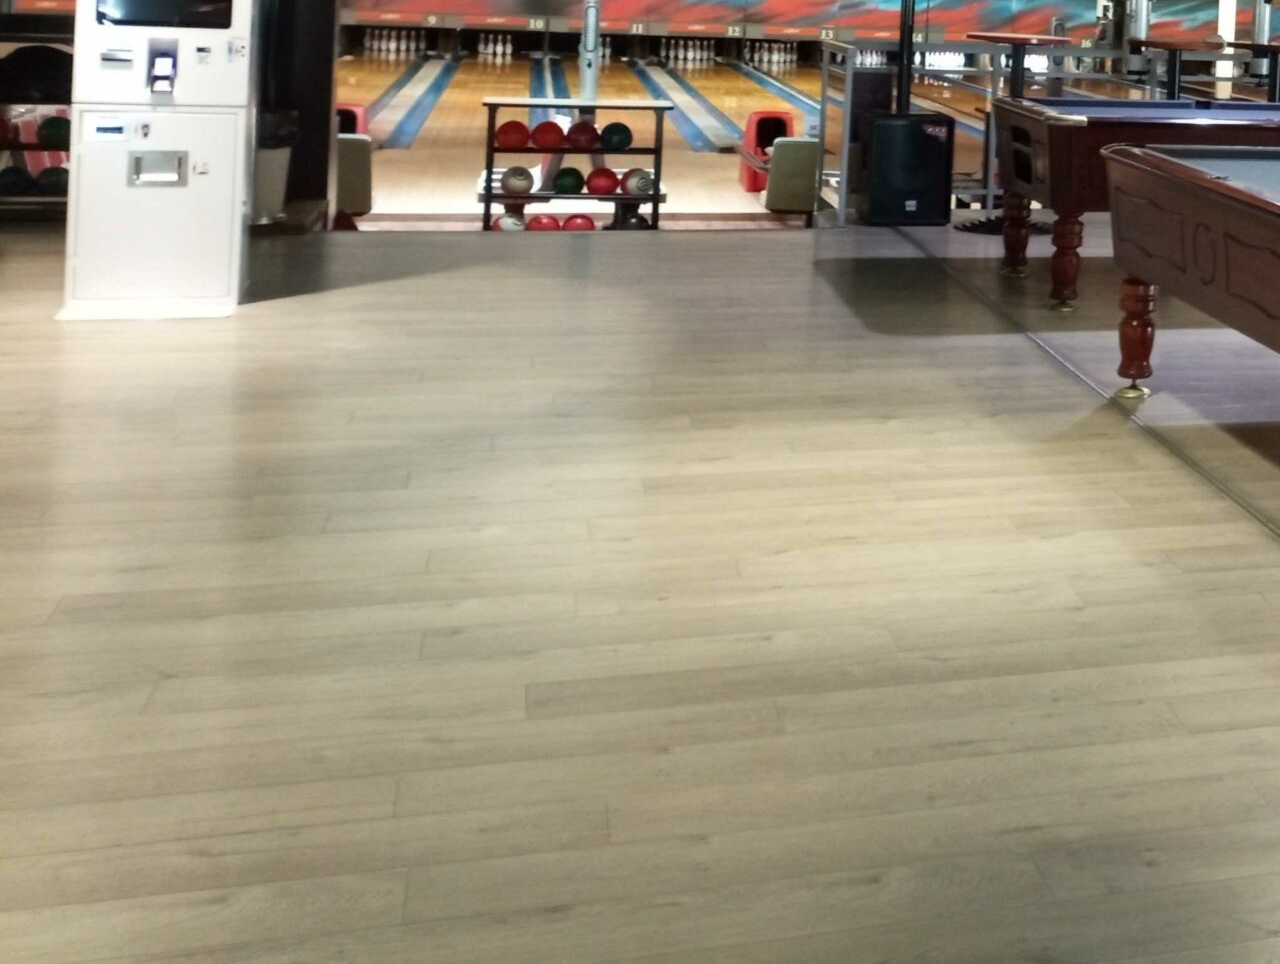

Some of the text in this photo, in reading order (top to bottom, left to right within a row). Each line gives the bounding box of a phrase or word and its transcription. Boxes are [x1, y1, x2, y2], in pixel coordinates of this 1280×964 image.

[427, 15, 437, 25] 9
[528, 18, 544, 30] 10
[631, 23, 643, 34] 11
[727, 26, 741, 36] 12
[820, 29, 834, 40] 13
